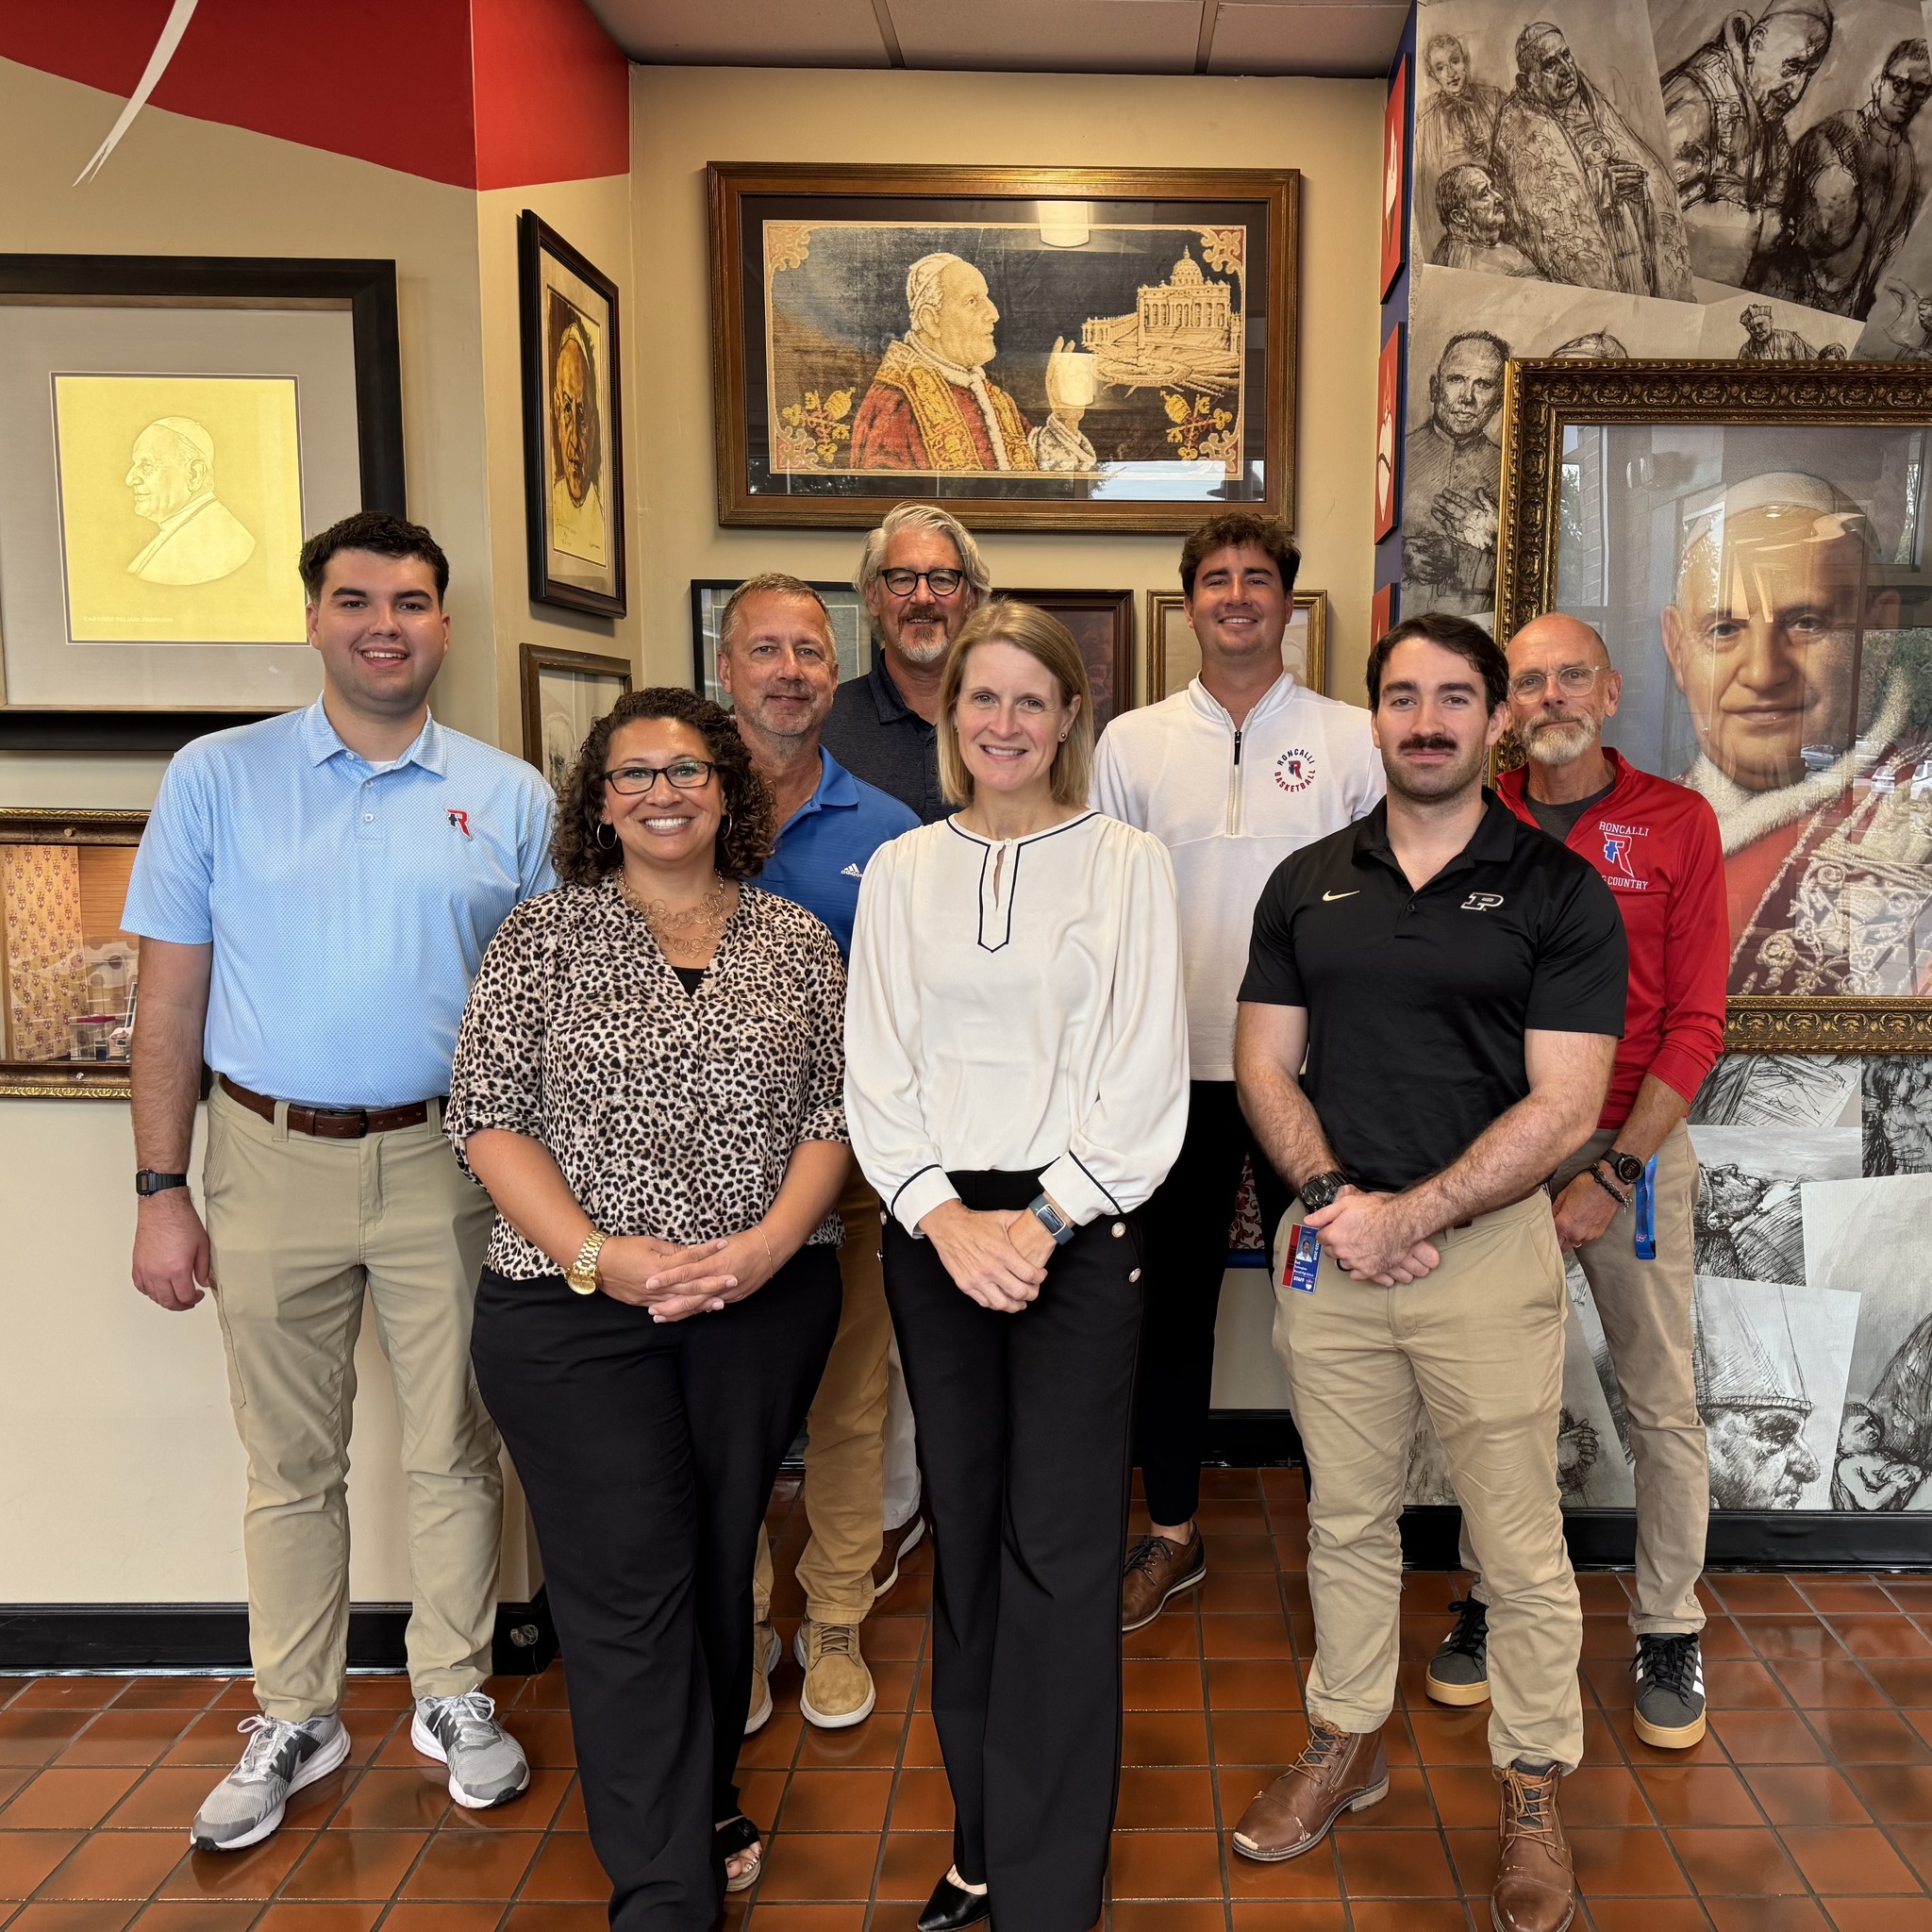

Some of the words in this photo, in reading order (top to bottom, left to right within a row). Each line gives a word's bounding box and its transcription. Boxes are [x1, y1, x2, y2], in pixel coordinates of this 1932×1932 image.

[1277, 748, 1315, 766] RONCALLI
[1274, 770, 1316, 792] BASKETBALL
[1599, 821, 1649, 837] RONCALLI
[1607, 875, 1649, 891] COUNTRY
[1460, 891, 1505, 911] P
